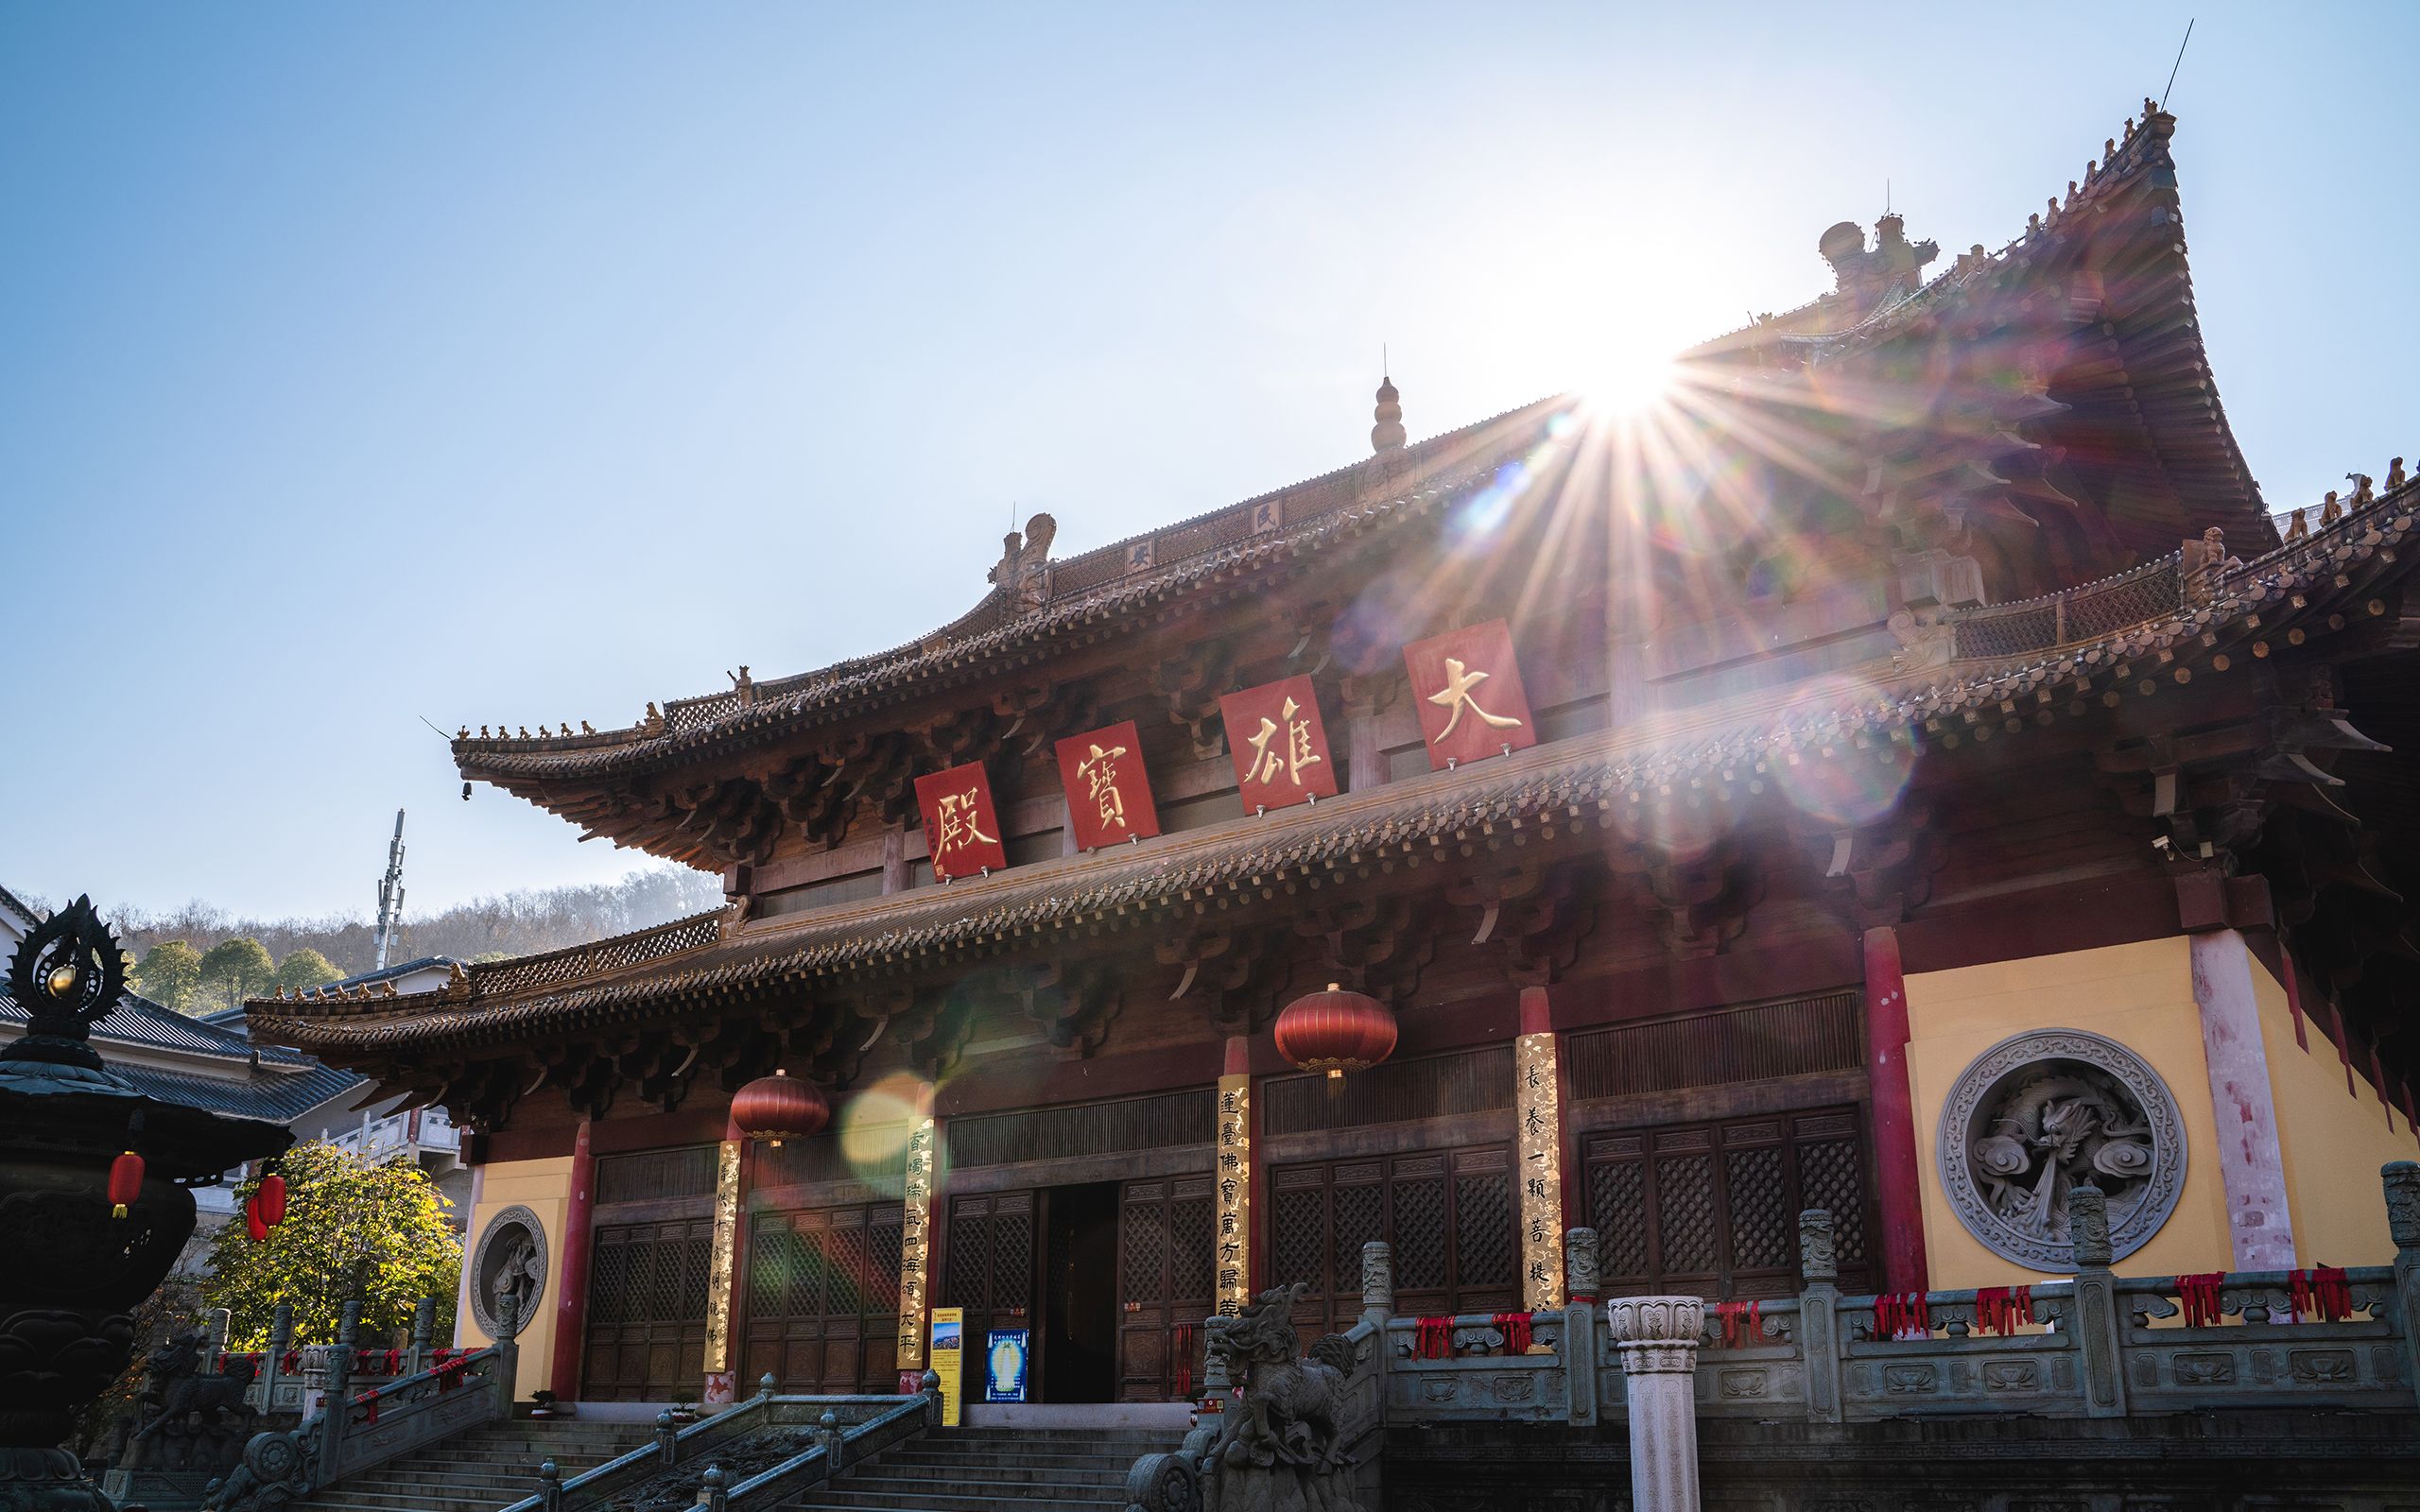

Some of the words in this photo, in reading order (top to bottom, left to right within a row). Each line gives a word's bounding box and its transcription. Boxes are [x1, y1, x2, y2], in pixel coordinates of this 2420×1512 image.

[1243, 696, 1322, 786] 雄
[1427, 658, 1523, 746] 大
[934, 786, 998, 866] 殿
[1077, 744, 1127, 832] 寶
